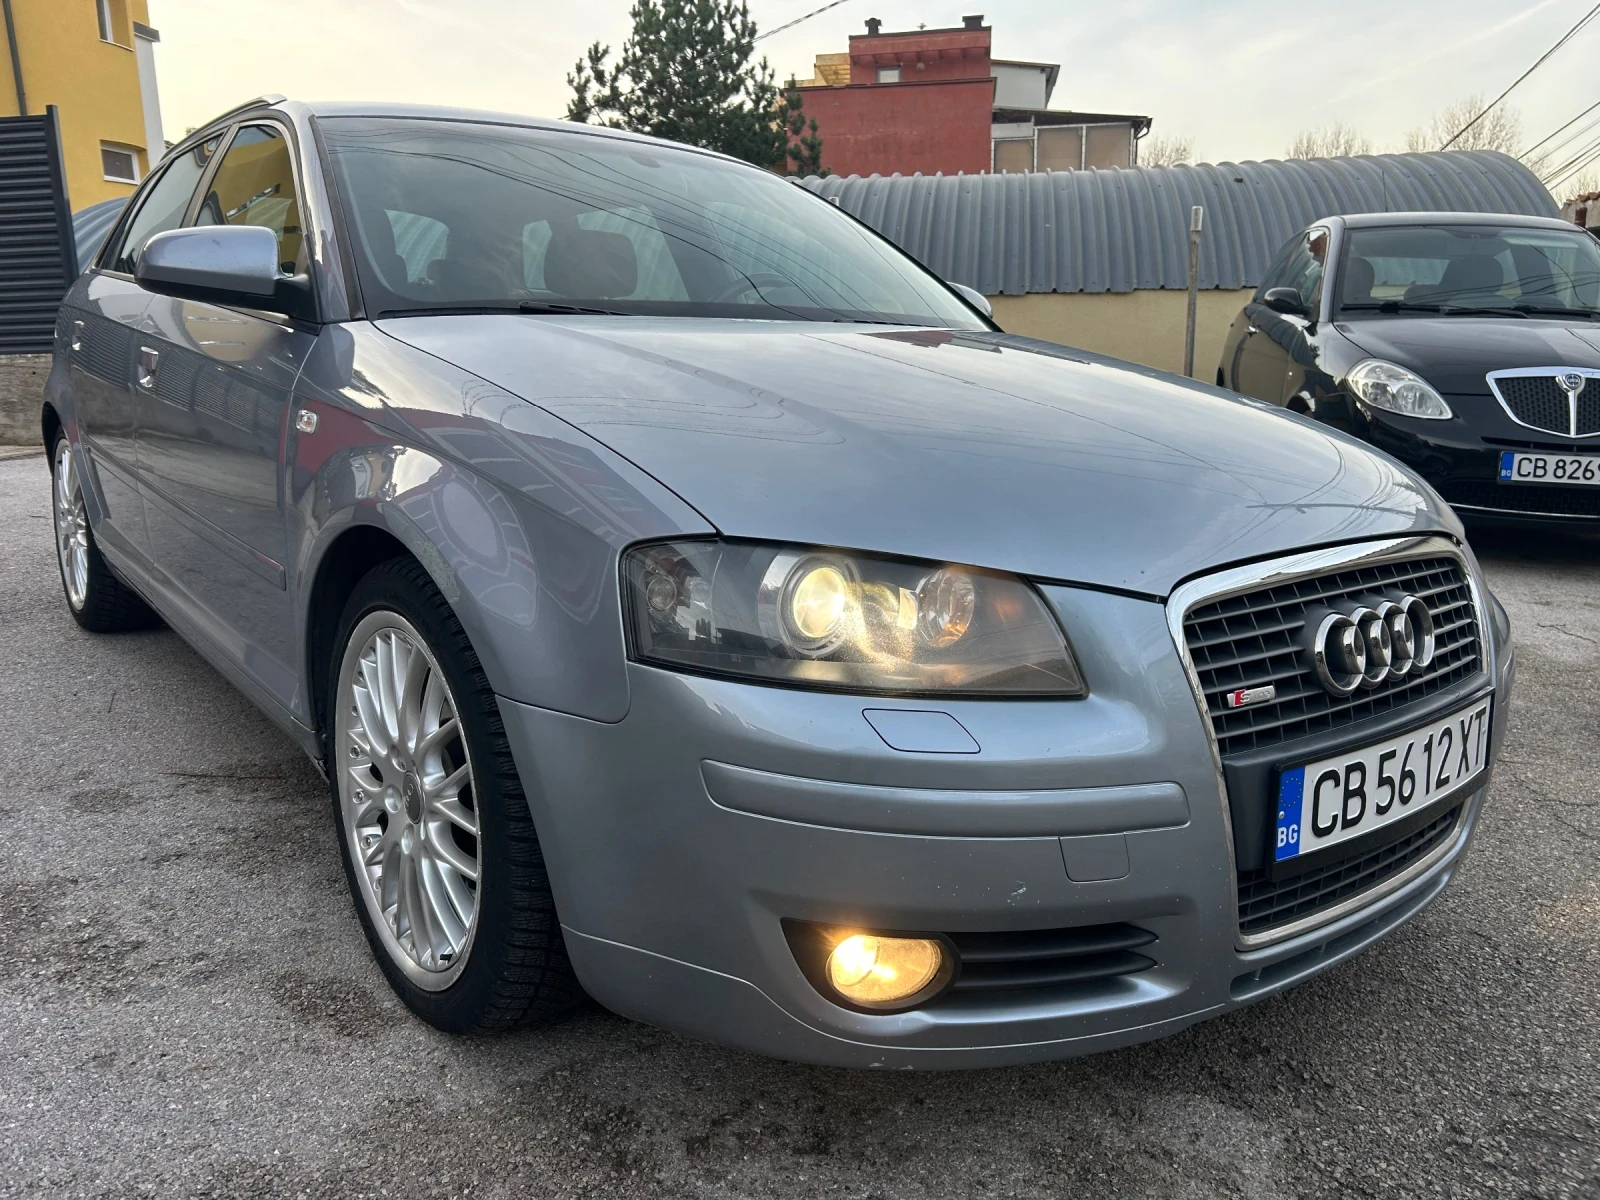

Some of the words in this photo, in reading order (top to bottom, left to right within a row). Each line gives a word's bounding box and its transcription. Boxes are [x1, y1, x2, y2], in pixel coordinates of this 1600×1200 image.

[1501, 469, 1511, 477] BG
[1517, 457, 1547, 478] CB
[1553, 459, 1600, 481] 826
[1277, 824, 1298, 847] BG
